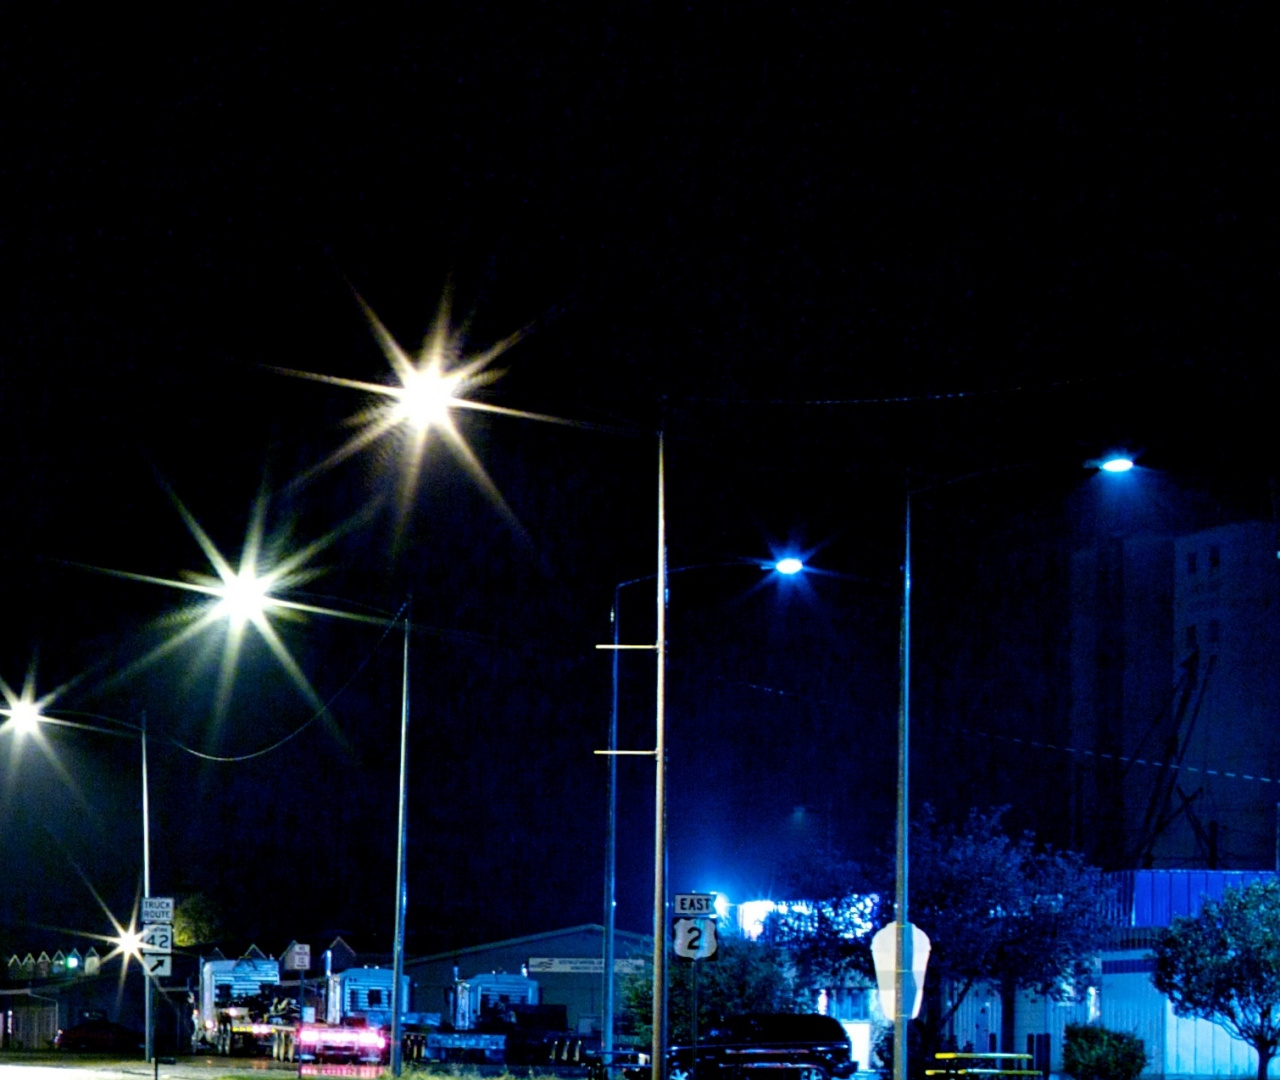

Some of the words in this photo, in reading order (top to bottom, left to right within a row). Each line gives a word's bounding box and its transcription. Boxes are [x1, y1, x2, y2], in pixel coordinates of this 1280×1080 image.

[144, 900, 171, 909] TRUCK
[680, 898, 711, 911] EAST
[144, 910, 171, 918] ROUTE
[146, 934, 169, 948] 42
[687, 926, 702, 950] 2
